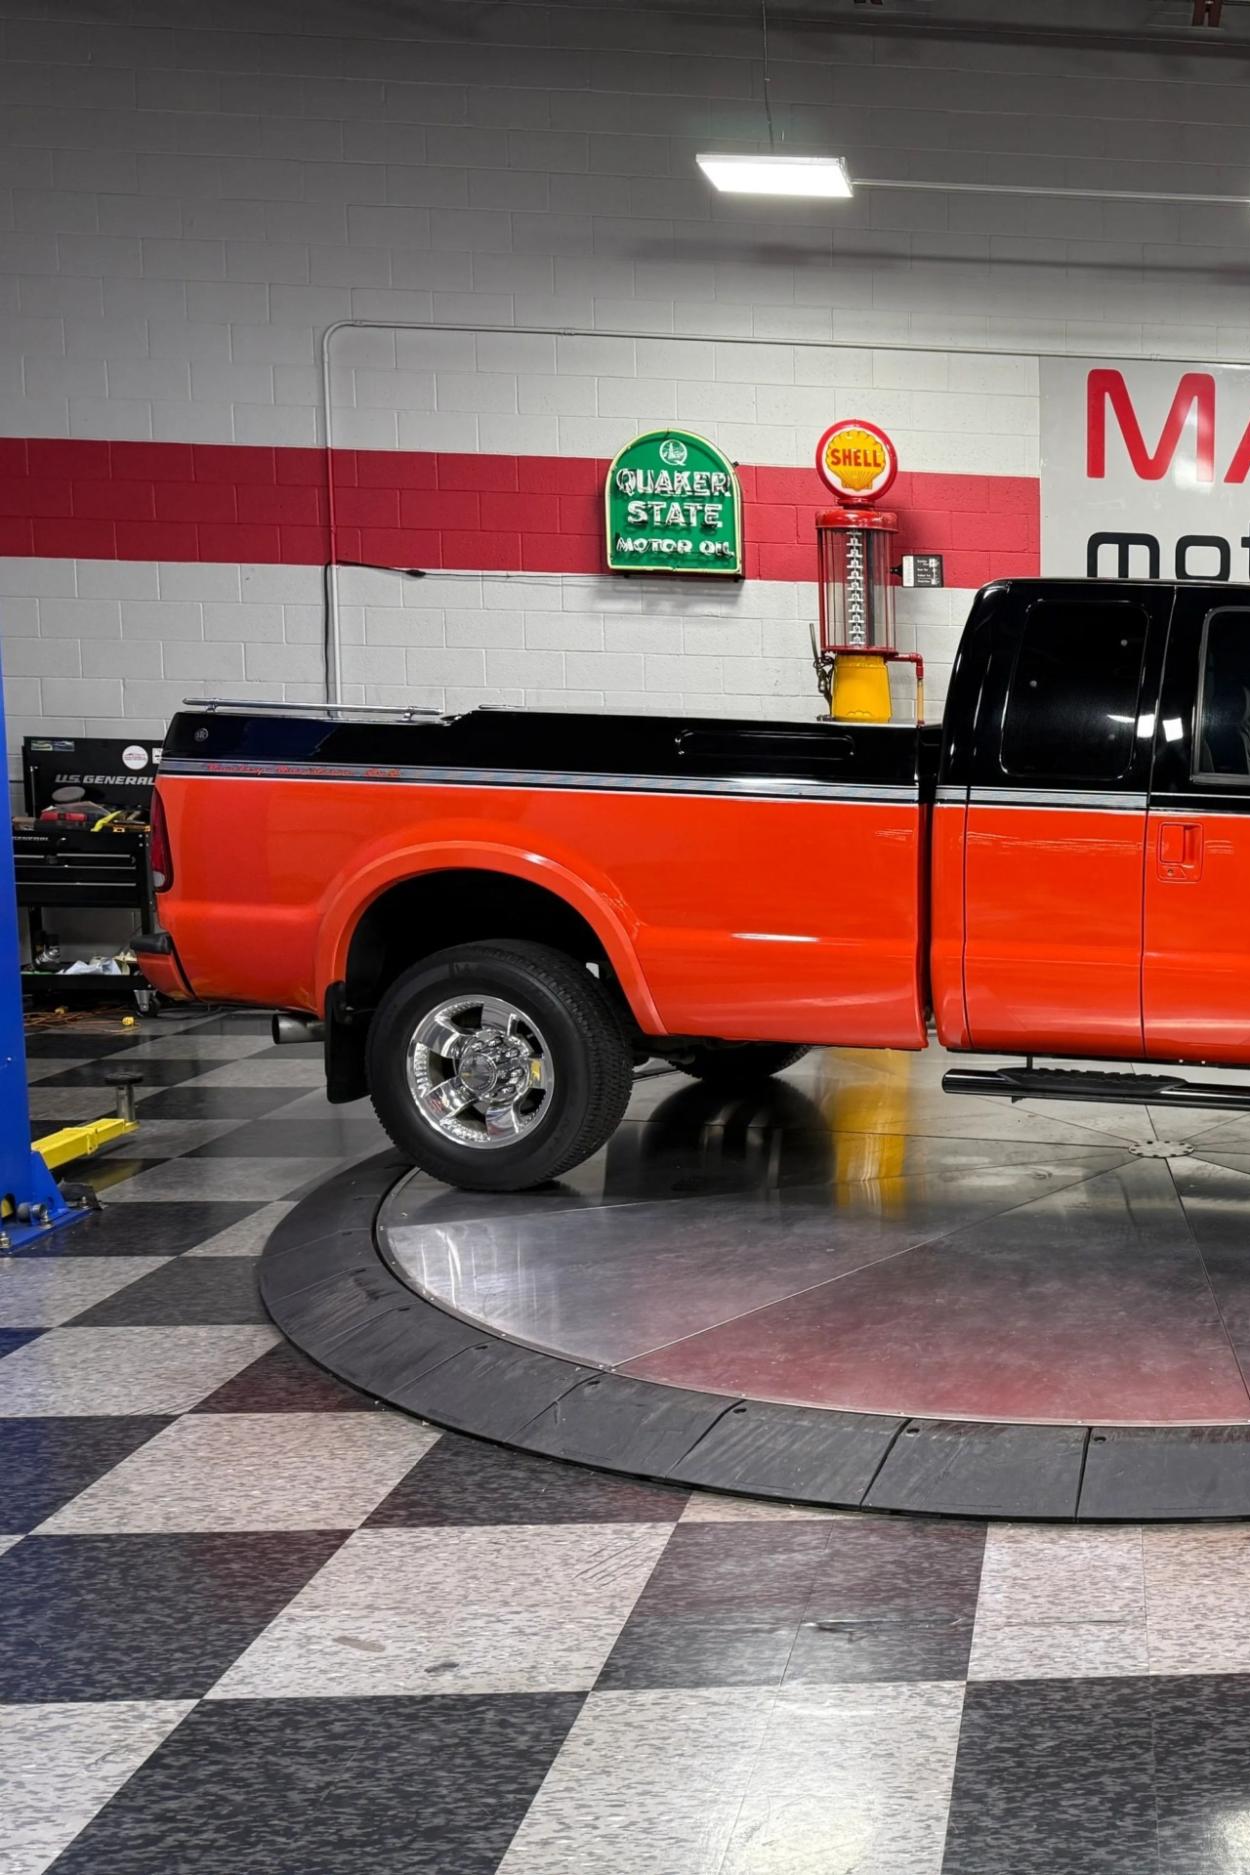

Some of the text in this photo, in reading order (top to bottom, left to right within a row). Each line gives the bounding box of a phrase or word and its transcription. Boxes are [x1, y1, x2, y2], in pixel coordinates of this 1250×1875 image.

[830, 449, 882, 469] SHELL
[616, 468, 731, 497] QUAKER
[627, 500, 723, 527] STATE
[616, 537, 735, 556] MOTOR OIL
[82, 774, 155, 785] GENERAL
